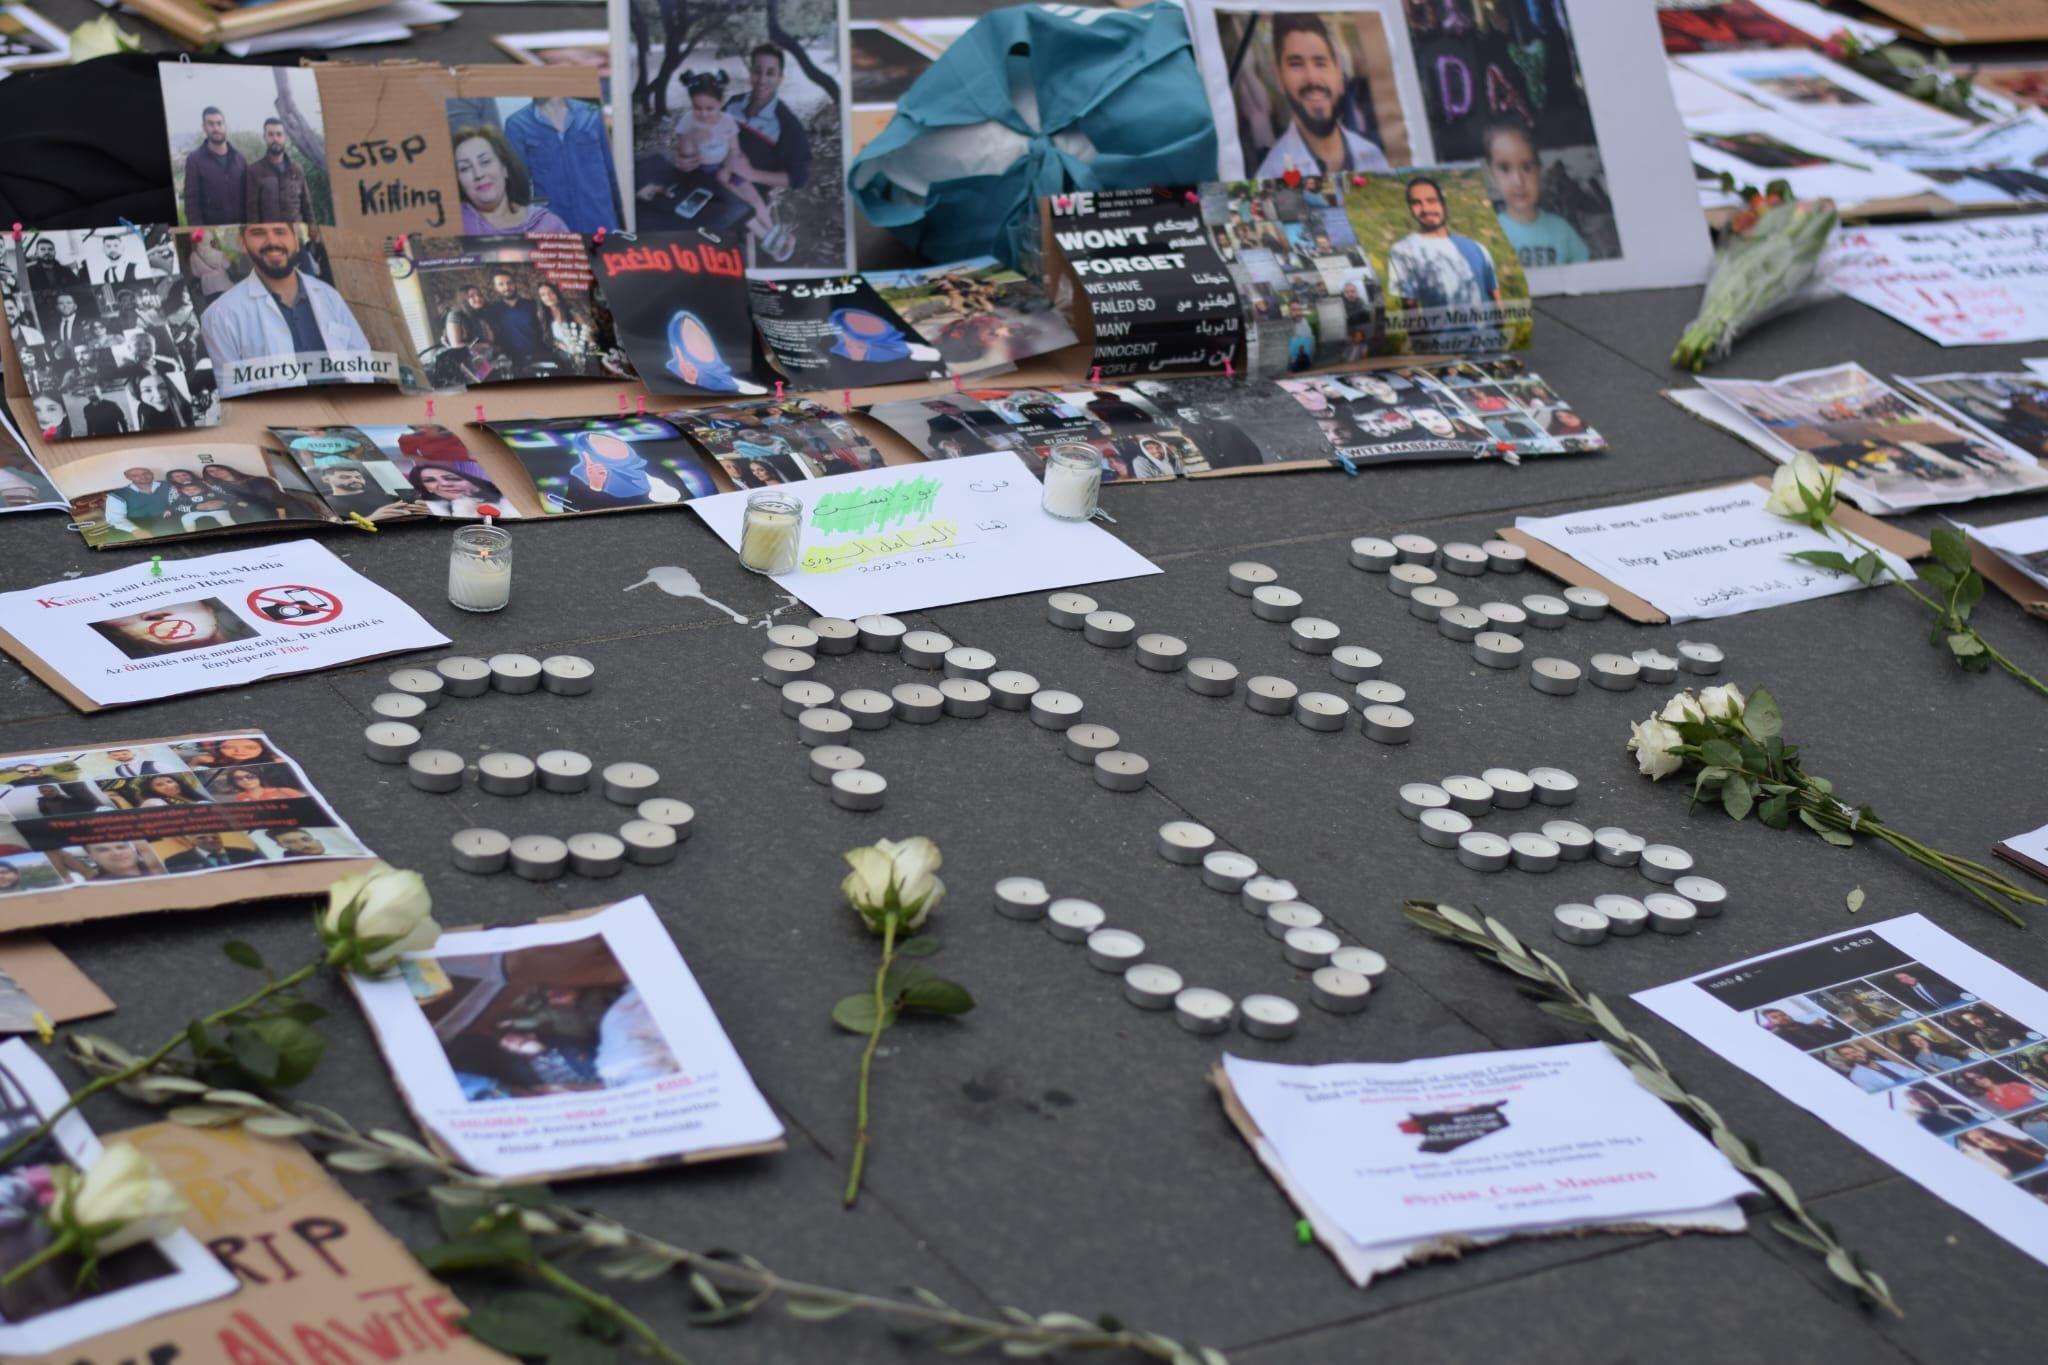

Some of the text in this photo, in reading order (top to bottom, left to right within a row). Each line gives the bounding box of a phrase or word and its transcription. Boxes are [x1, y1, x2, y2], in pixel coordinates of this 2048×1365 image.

[339, 134, 427, 170] STOP
[358, 178, 445, 228] Killing
[1051, 191, 1095, 216] WE
[1055, 227, 1149, 250] WON'T
[1072, 253, 1186, 276] FORGET
[1084, 280, 1143, 295] WE HAVE
[1092, 298, 1156, 315] FAILED SO
[1096, 322, 1131, 337] MANY
[1094, 342, 1158, 358] INNOCENT
[233, 355, 393, 385] Martyr Bashar
[1618, 556, 1659, 568] Stop
[37, 594, 99, 609] Killing
[113, 583, 140, 593] Still
[141, 574, 181, 587] Going
[232, 560, 285, 573] Media
[109, 577, 245, 608] Blackouts and Hides
[105, 667, 122, 676] Az
[182, 653, 209, 664] még
[210, 643, 254, 659] mindig
[299, 631, 317, 640] De
[201, 644, 310, 670] fényképezni Tilos
[205, 1216, 350, 1285] RIP
